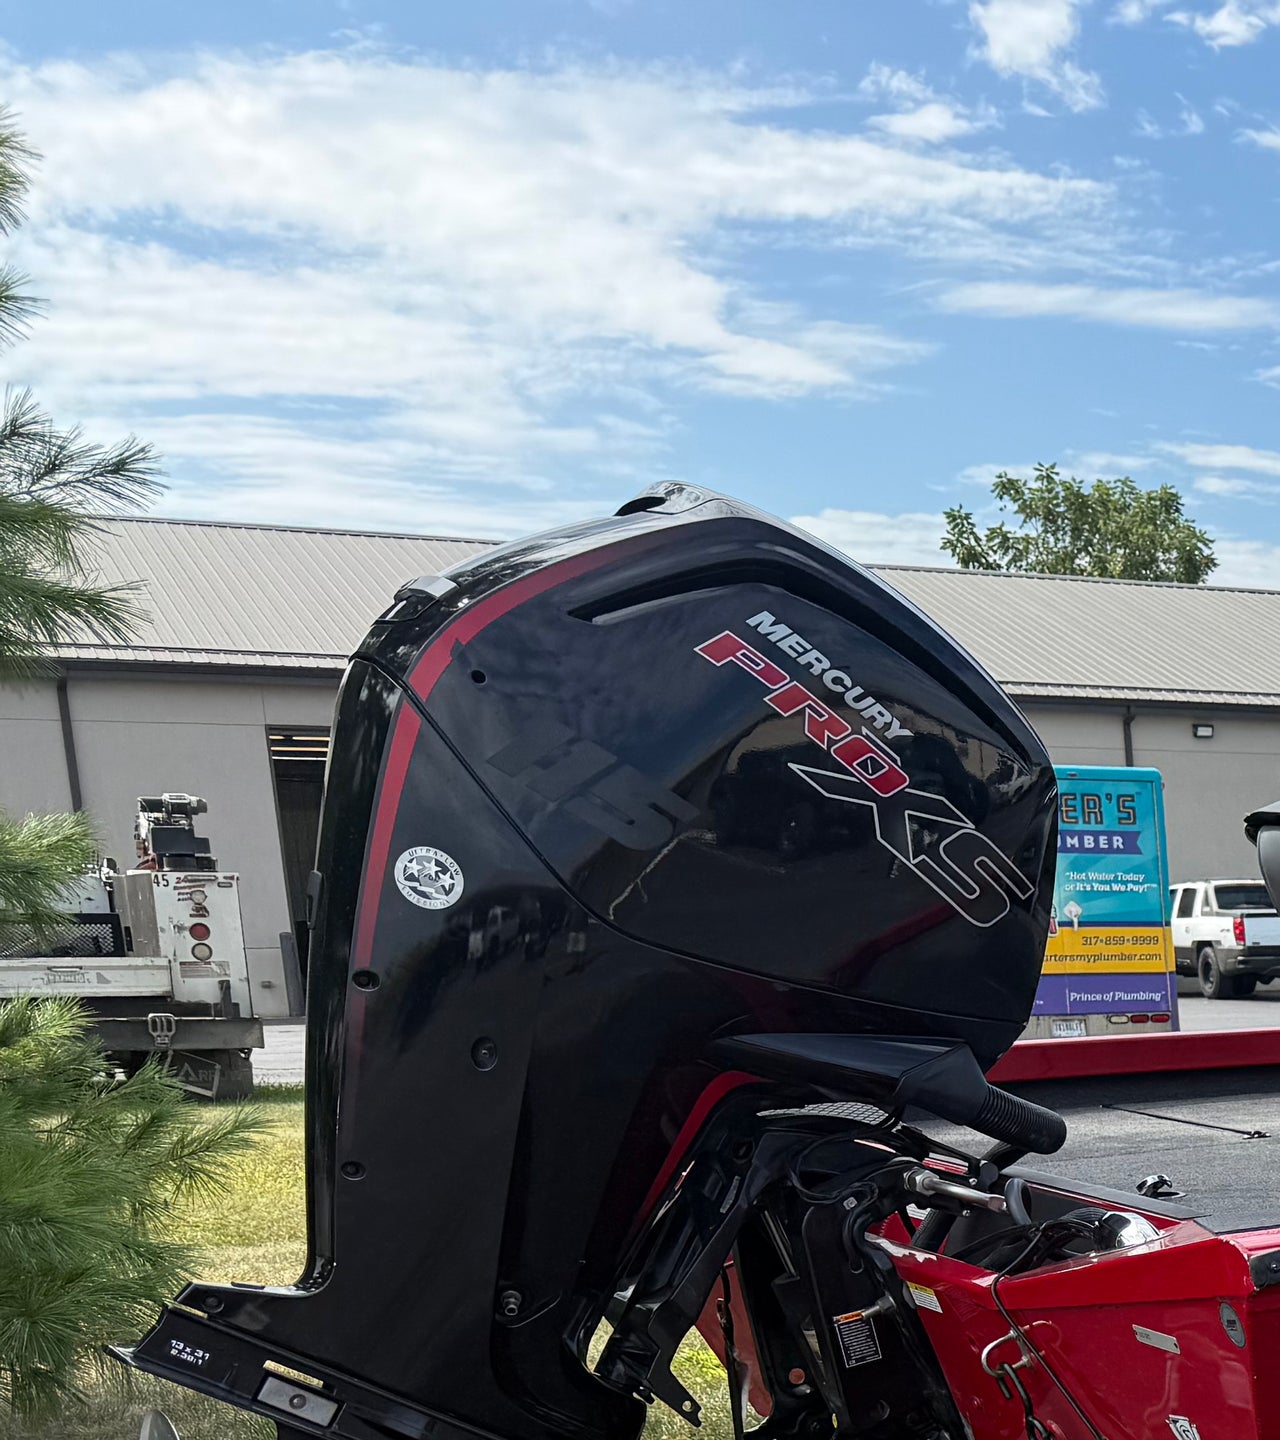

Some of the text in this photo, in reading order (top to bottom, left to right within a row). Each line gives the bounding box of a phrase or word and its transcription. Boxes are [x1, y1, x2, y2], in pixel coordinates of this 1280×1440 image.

[746, 611, 914, 739] MERCURY
[694, 630, 909, 797] PRO
[1059, 792, 1138, 825] ER'S
[787, 726, 1036, 927] XS
[1057, 835, 1124, 849] MBER
[153, 873, 170, 888] 45
[1088, 872, 1115, 881] Water
[1117, 872, 1145, 882] Today
[1092, 883, 1111, 892] You
[1112, 883, 1126, 892] We
[1070, 991, 1162, 1002] Prince of Plumbing
